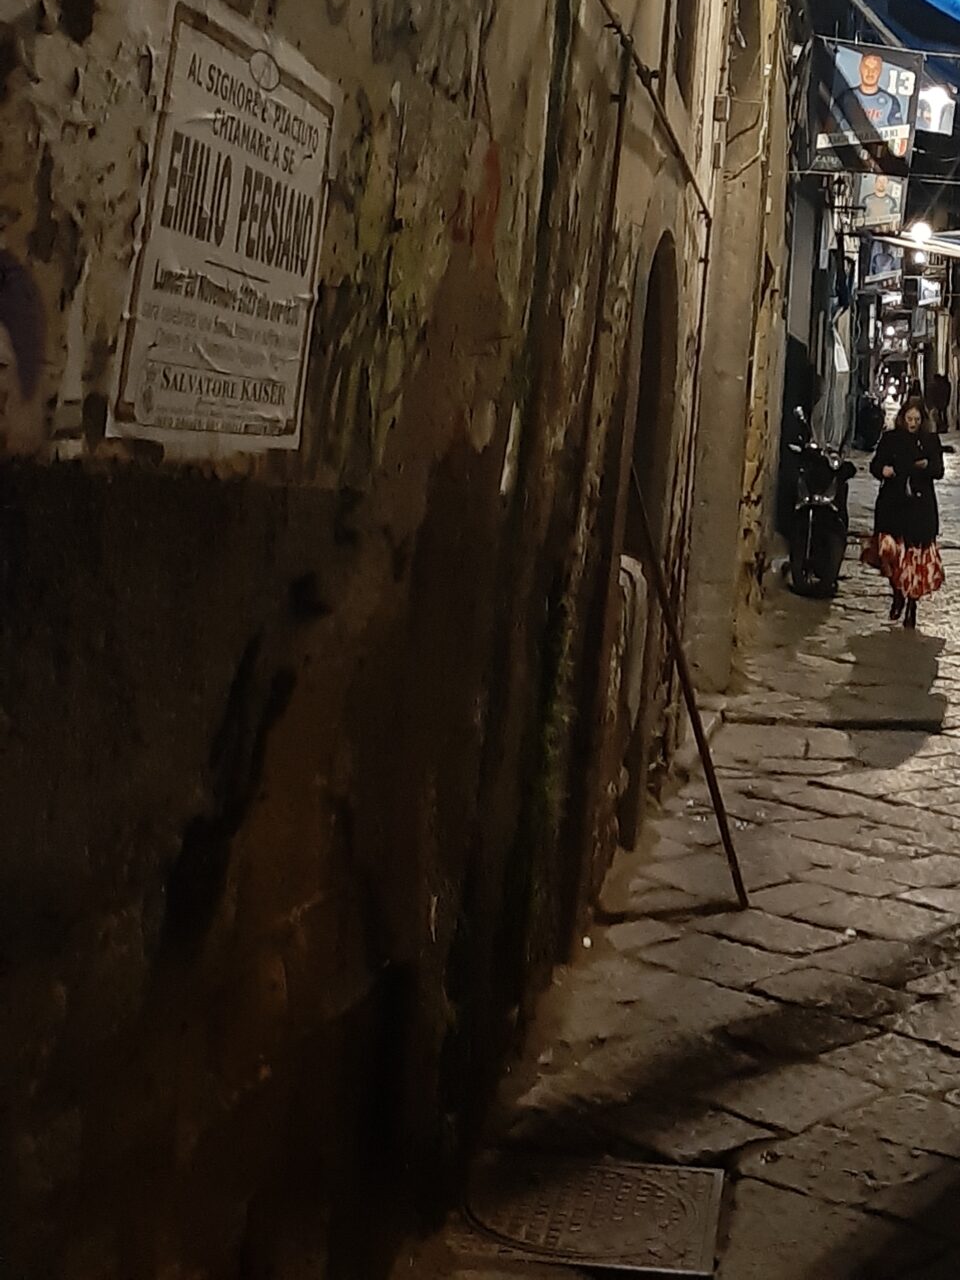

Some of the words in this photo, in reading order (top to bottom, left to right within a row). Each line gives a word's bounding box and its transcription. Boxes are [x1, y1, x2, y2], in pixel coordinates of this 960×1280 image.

[187, 52, 203, 88] AL
[206, 63, 262, 117] SIGNORE
[887, 69, 916, 96] 13
[213, 107, 272, 162] CHIAMARE
[272, 141, 280, 168] A
[281, 145, 296, 175] SE
[160, 129, 232, 247] EMILIO
[234, 164, 315, 278] PERSIANO
[160, 365, 237, 400] SALVATORE
[240, 378, 287, 406] KAISER
